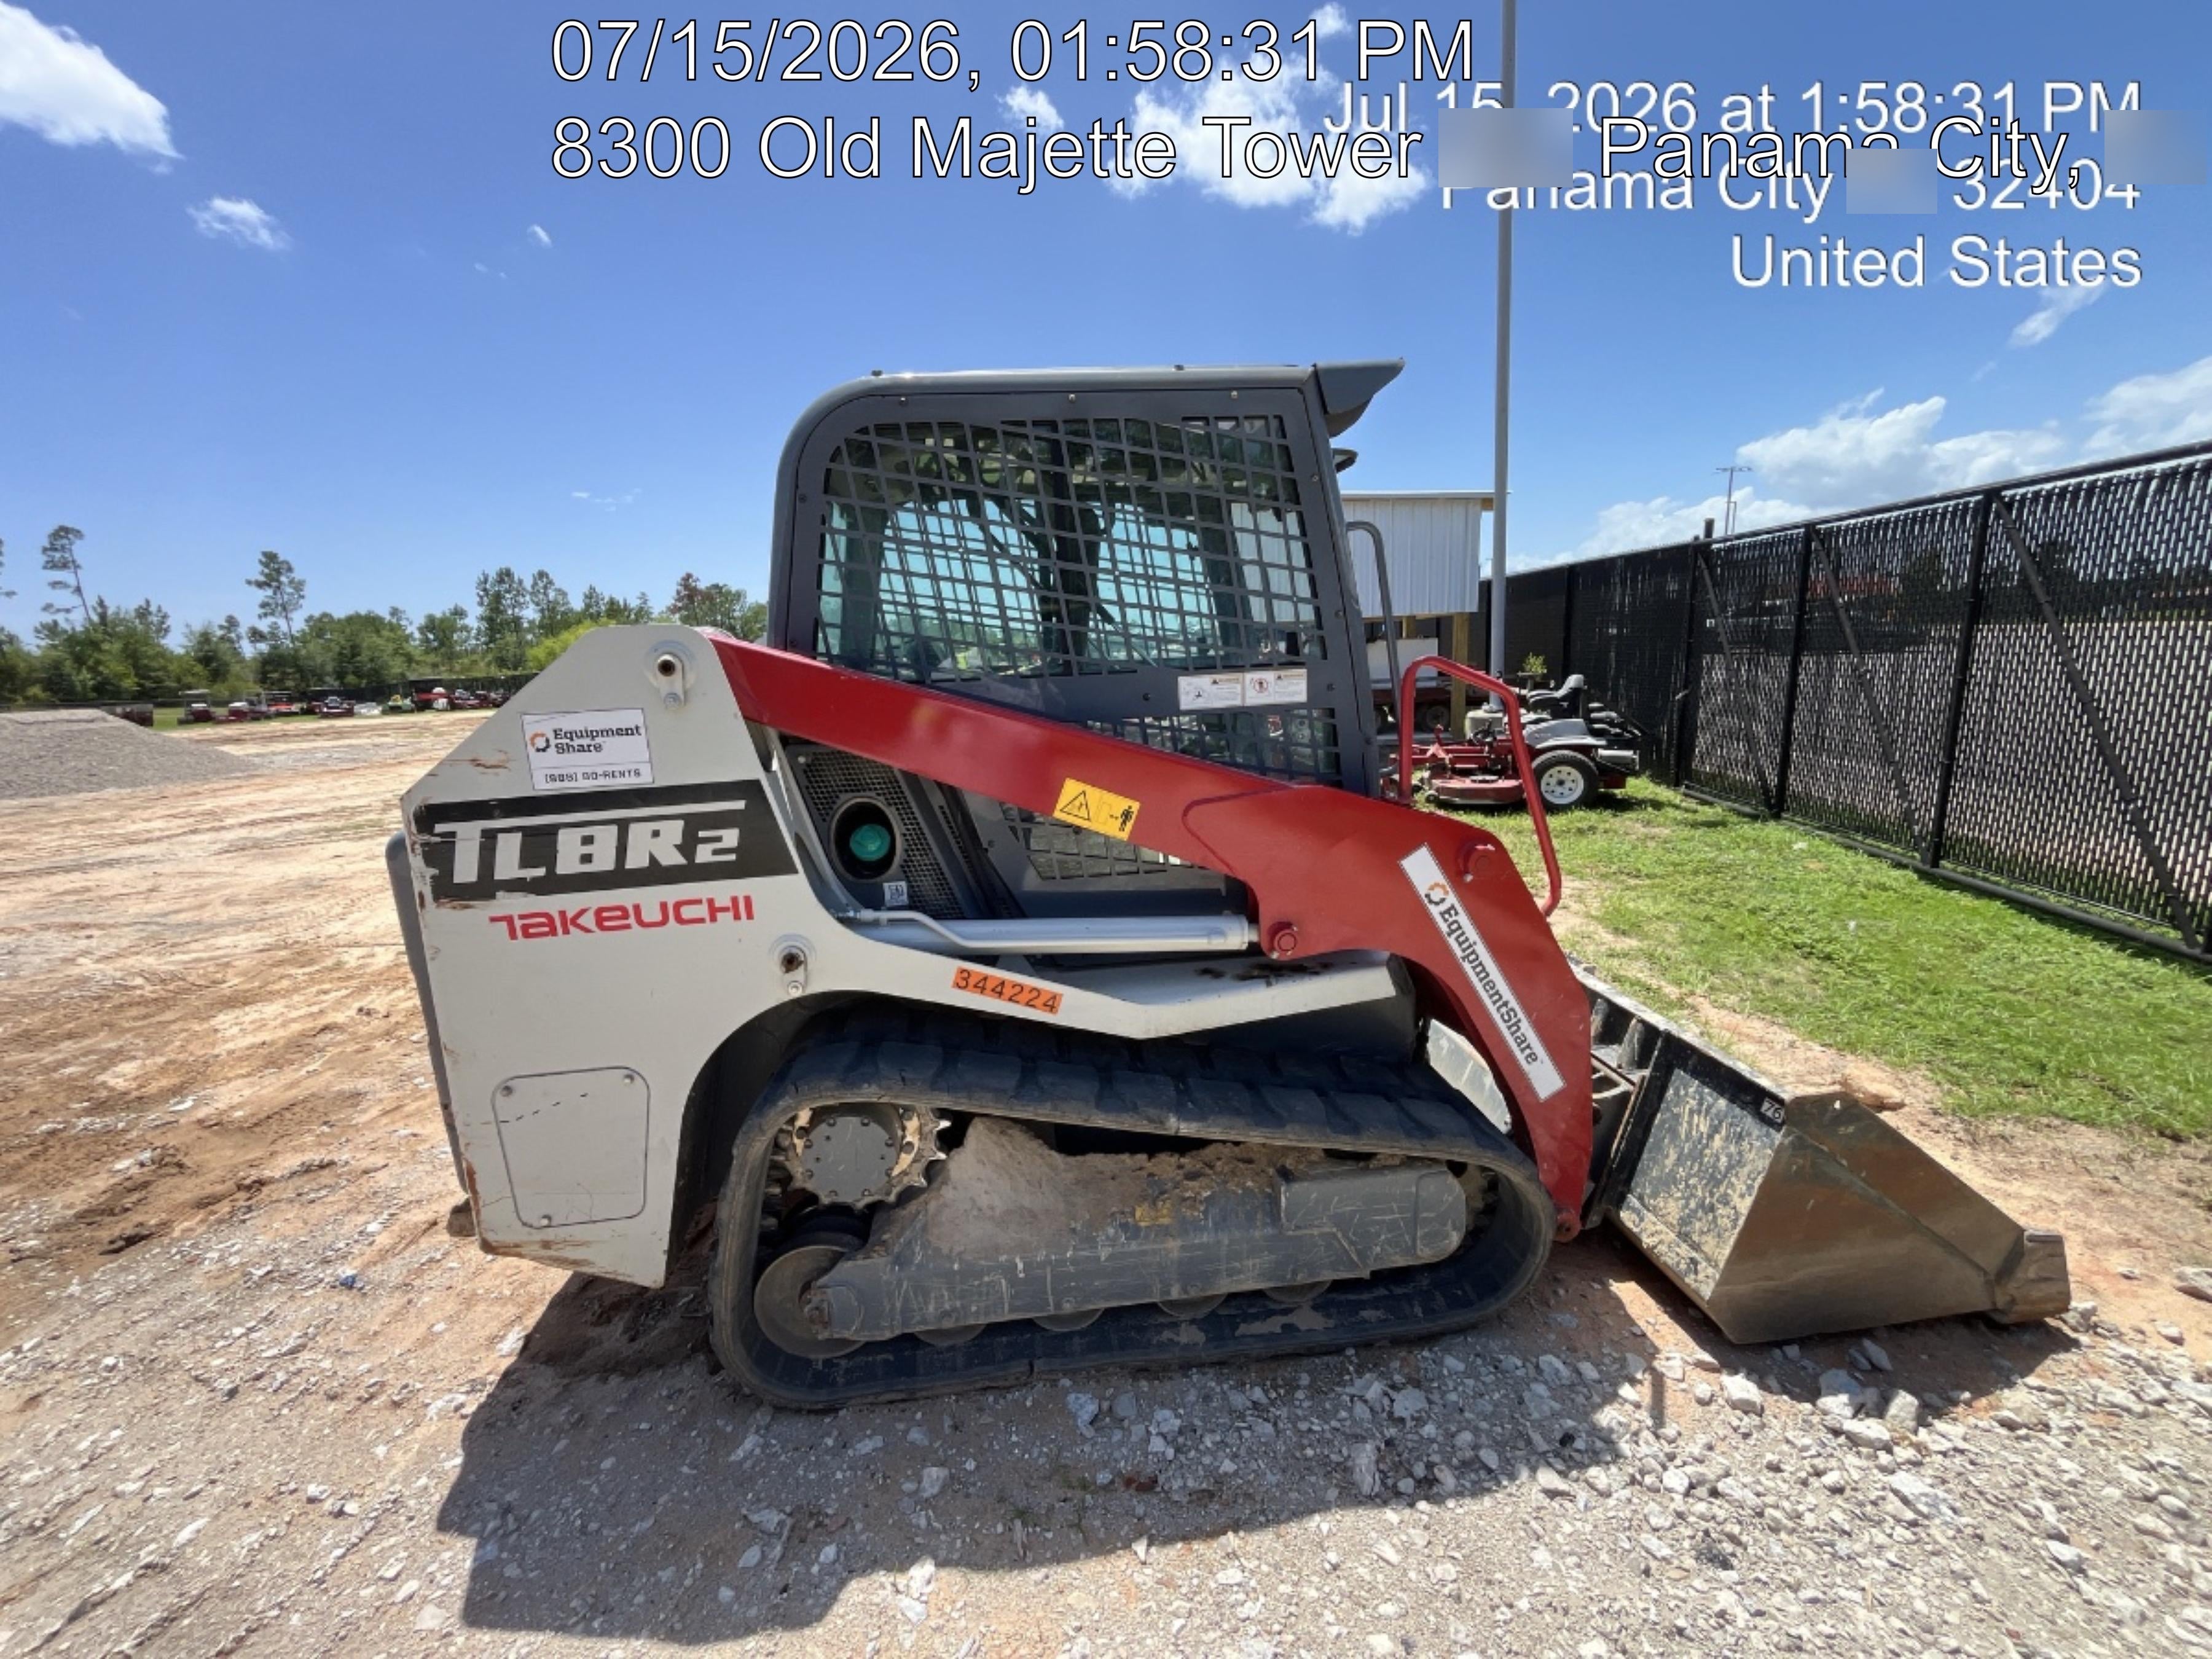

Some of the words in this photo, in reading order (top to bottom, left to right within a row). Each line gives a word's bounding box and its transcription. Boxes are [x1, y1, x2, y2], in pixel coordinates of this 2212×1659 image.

[553, 724, 642, 742] Equipment
[554, 742, 603, 755] Share
[956, 969, 1057, 1013] 344224
[1439, 903, 1539, 1065] EquipmentShare
